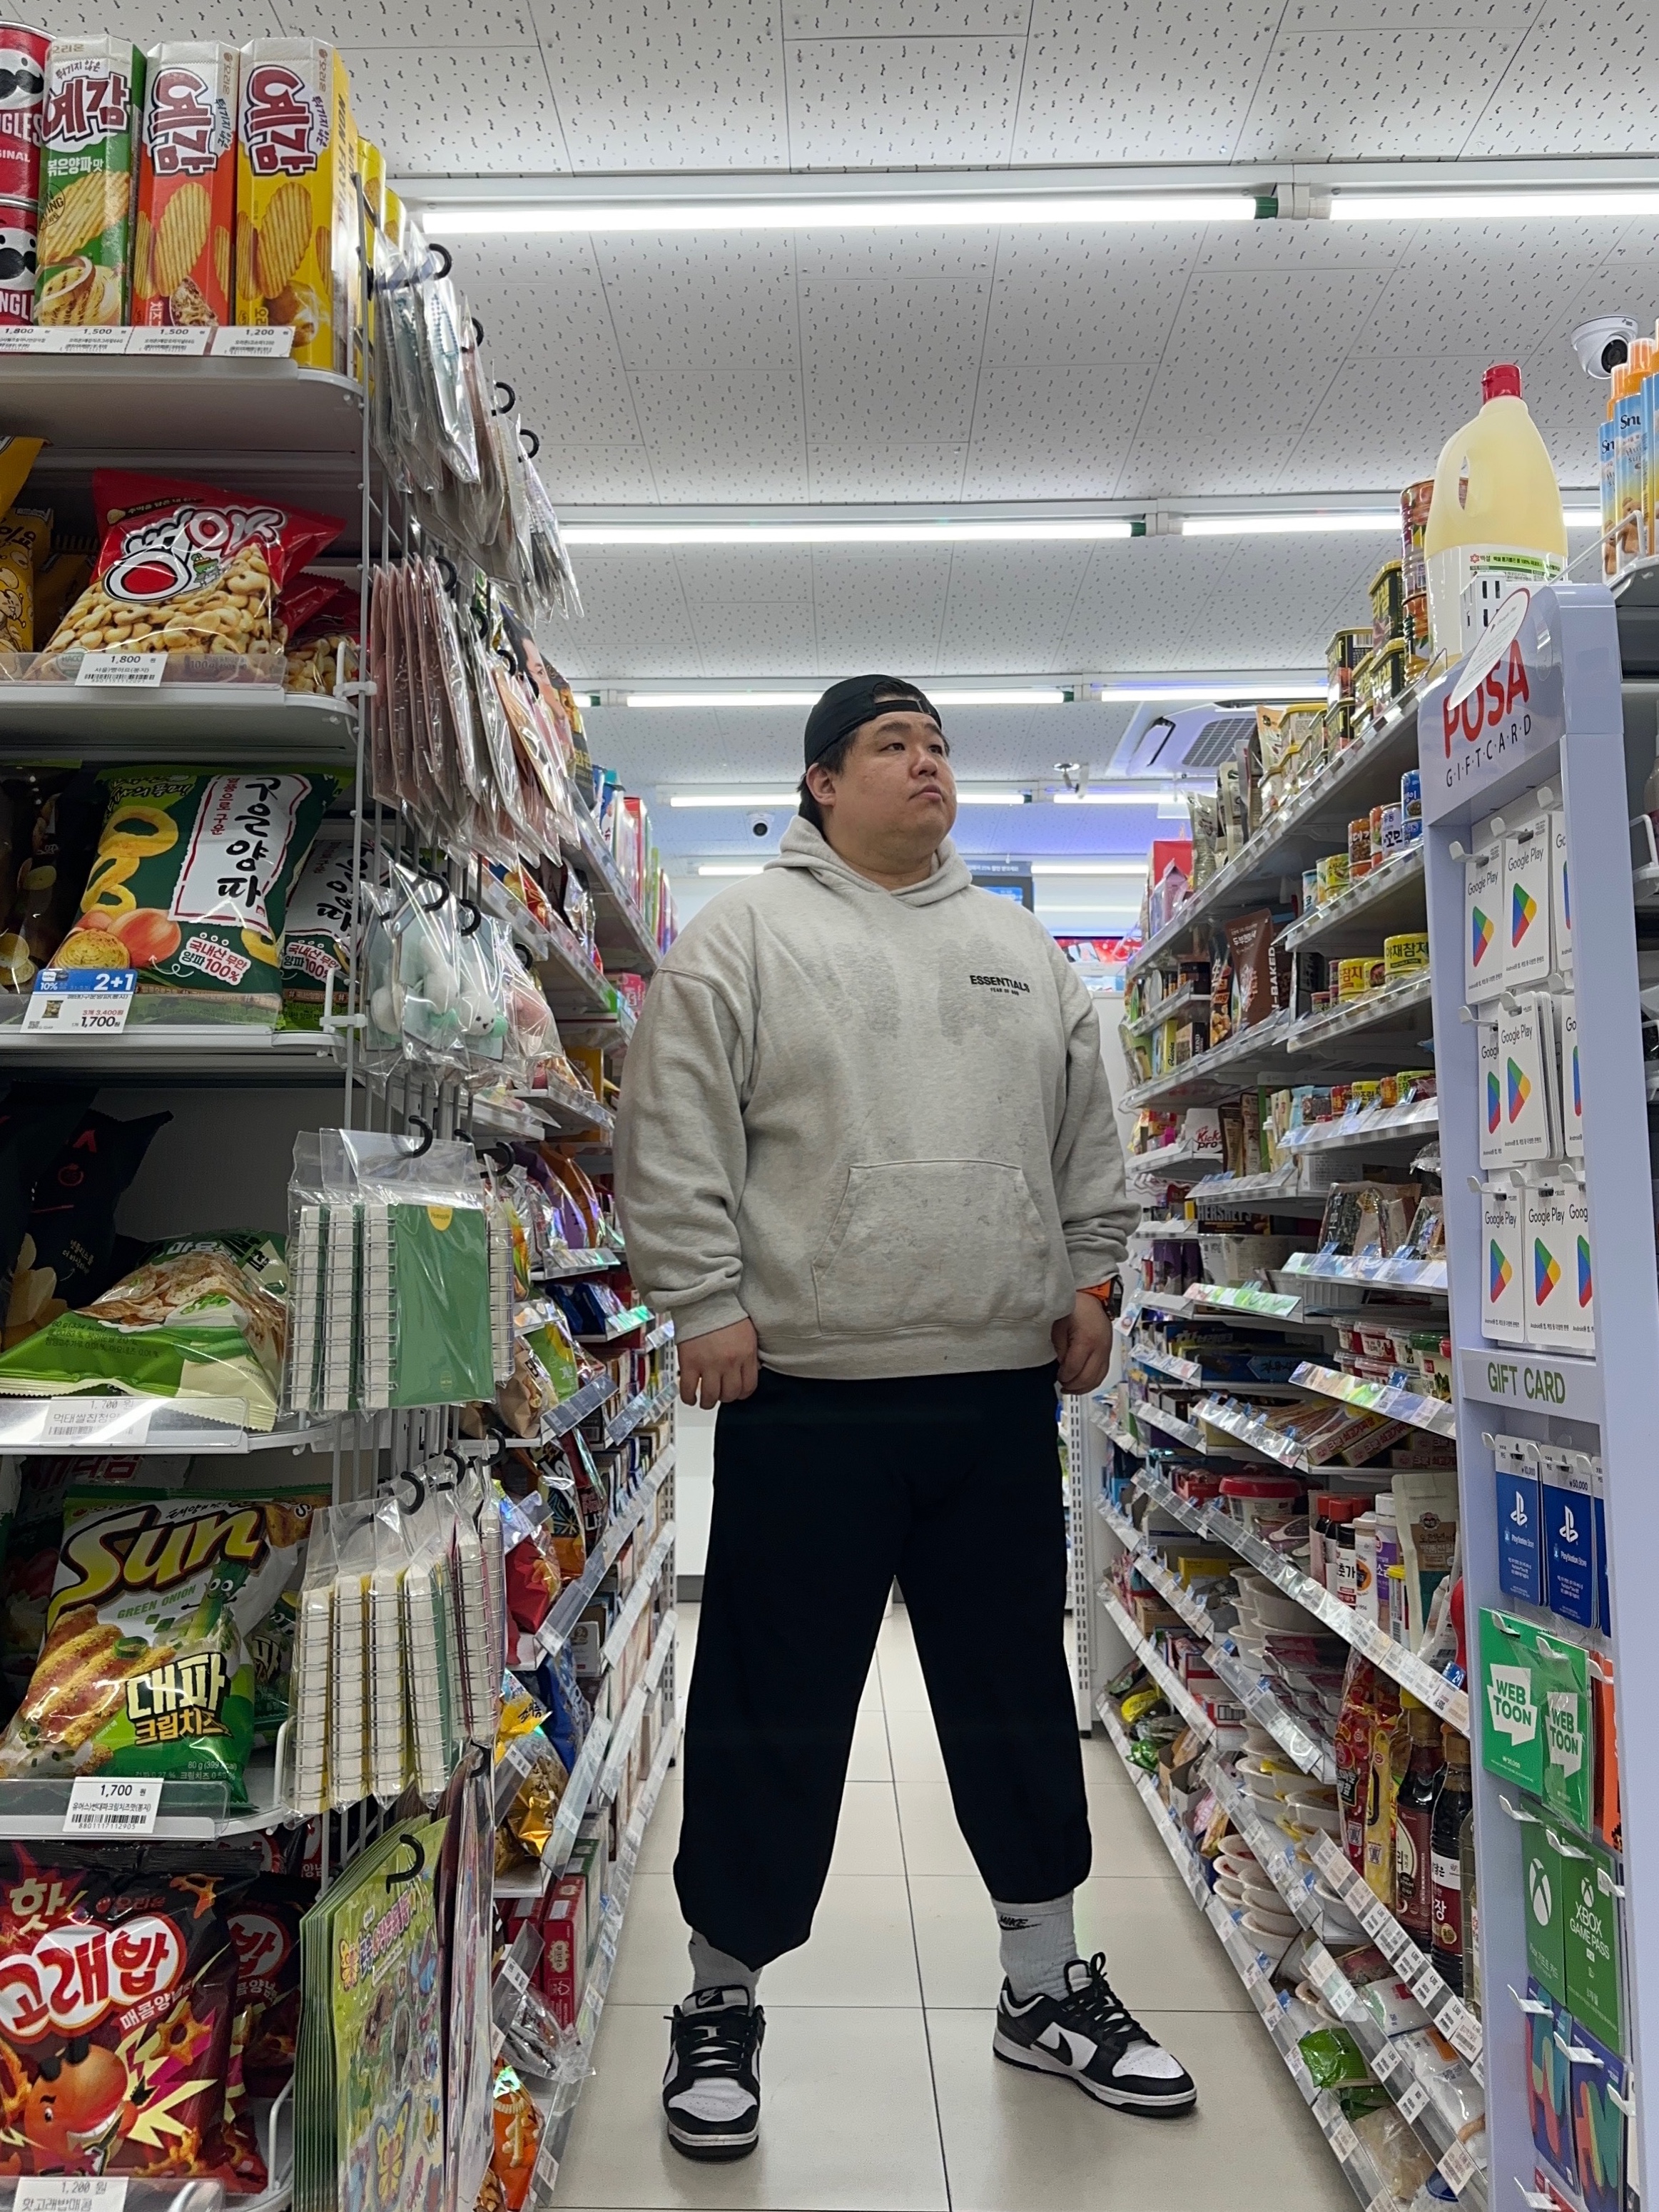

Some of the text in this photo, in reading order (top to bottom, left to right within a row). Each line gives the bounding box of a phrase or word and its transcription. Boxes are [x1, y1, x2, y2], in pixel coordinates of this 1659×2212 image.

[43, 73, 128, 141] 예감
[150, 69, 215, 175] 예감
[246, 66, 315, 175] 예감
[0, 112, 44, 146] GLES
[111, 655, 141, 664] 1,800
[1443, 639, 1530, 759] POSA
[217, 777, 282, 908] 구운양파
[1508, 847, 1545, 872] Google Play
[1468, 871, 1499, 896] Google Play
[181, 950, 240, 983] 양파 100%
[188, 939, 248, 971] 국내산 무안
[288, 943, 323, 960] 국내산
[40, 982, 59, 990] 10%
[93, 973, 134, 991] 2+1
[970, 975, 1030, 993] ESSENTIALS
[1501, 1023, 1533, 1045] Google Play
[1485, 1211, 1516, 1228] Google Play
[1528, 1205, 1565, 1226] Google Play
[1488, 1362, 1566, 1404] GIFT CARD
[49, 1503, 265, 1615] Sun
[117, 1584, 198, 1620] GREEN ONION
[126, 1652, 226, 1720] 대파
[1496, 1679, 1526, 1705] WEB
[136, 1708, 232, 1745] 크림치즈
[1493, 1695, 1532, 1728] TOON
[1551, 1707, 1575, 1735] WEB
[1549, 1725, 1578, 1757] TOON
[180, 1771, 210, 1780] 크림치즈
[188, 1761, 197, 1770] 80
[101, 1784, 147, 1797] 1,700 원
[9, 1877, 67, 1936] 핫
[116, 1896, 166, 1912] 오리온
[1575, 1900, 1603, 1938] XBOX
[999, 1914, 1028, 1927] NIKE
[1569, 1917, 1610, 1960] GAME PASS
[0, 1929, 169, 2030] 고래밥
[61, 2181, 91, 2194] 1,200
